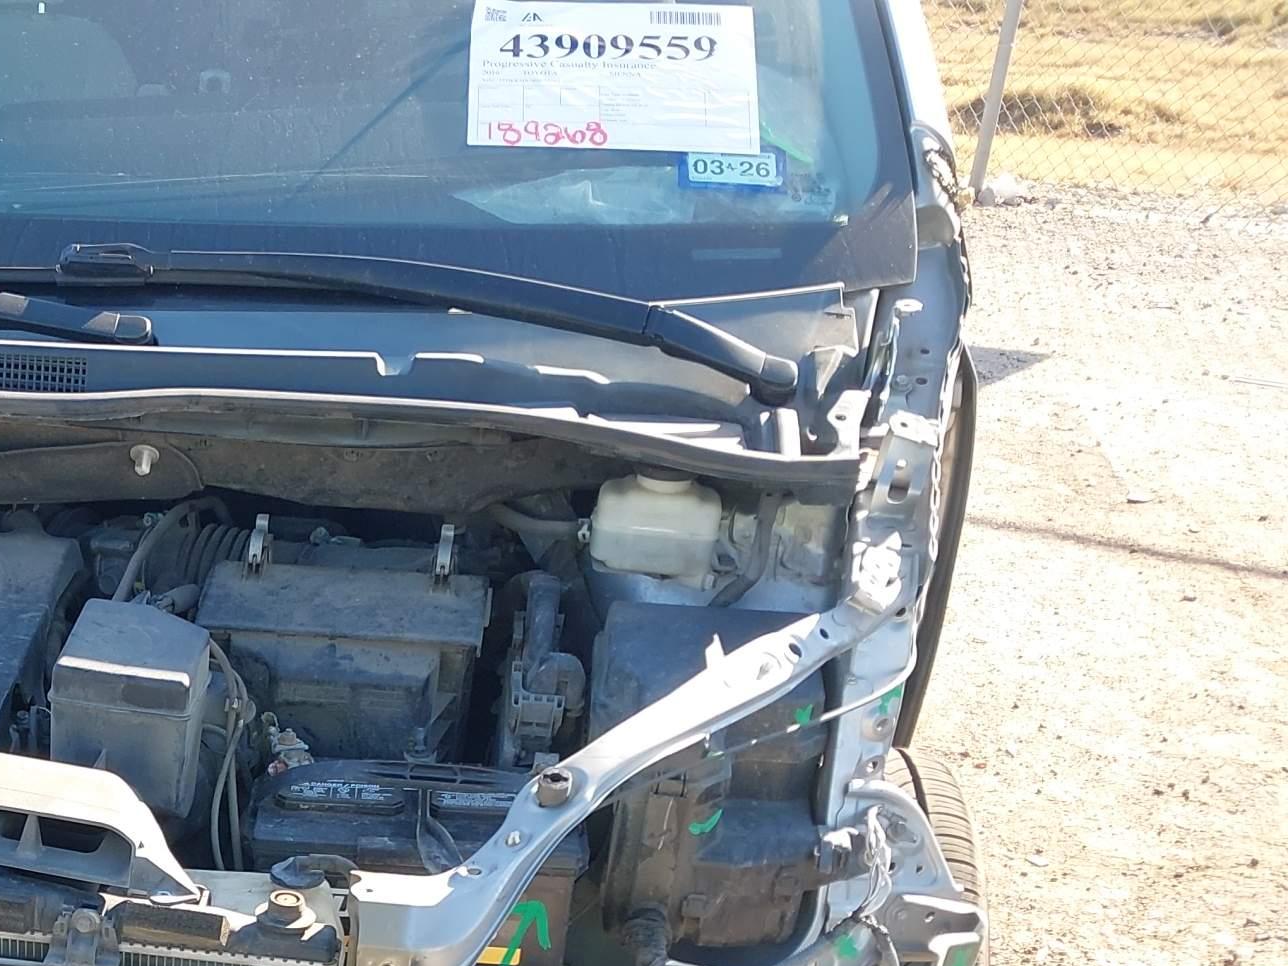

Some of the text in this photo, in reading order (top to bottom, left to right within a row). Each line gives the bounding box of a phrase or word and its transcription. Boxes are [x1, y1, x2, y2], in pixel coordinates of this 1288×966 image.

[499, 33, 718, 61] 43909559
[482, 60, 657, 70] Progressive Casualty Insurance
[692, 158, 771, 178] 03 26
